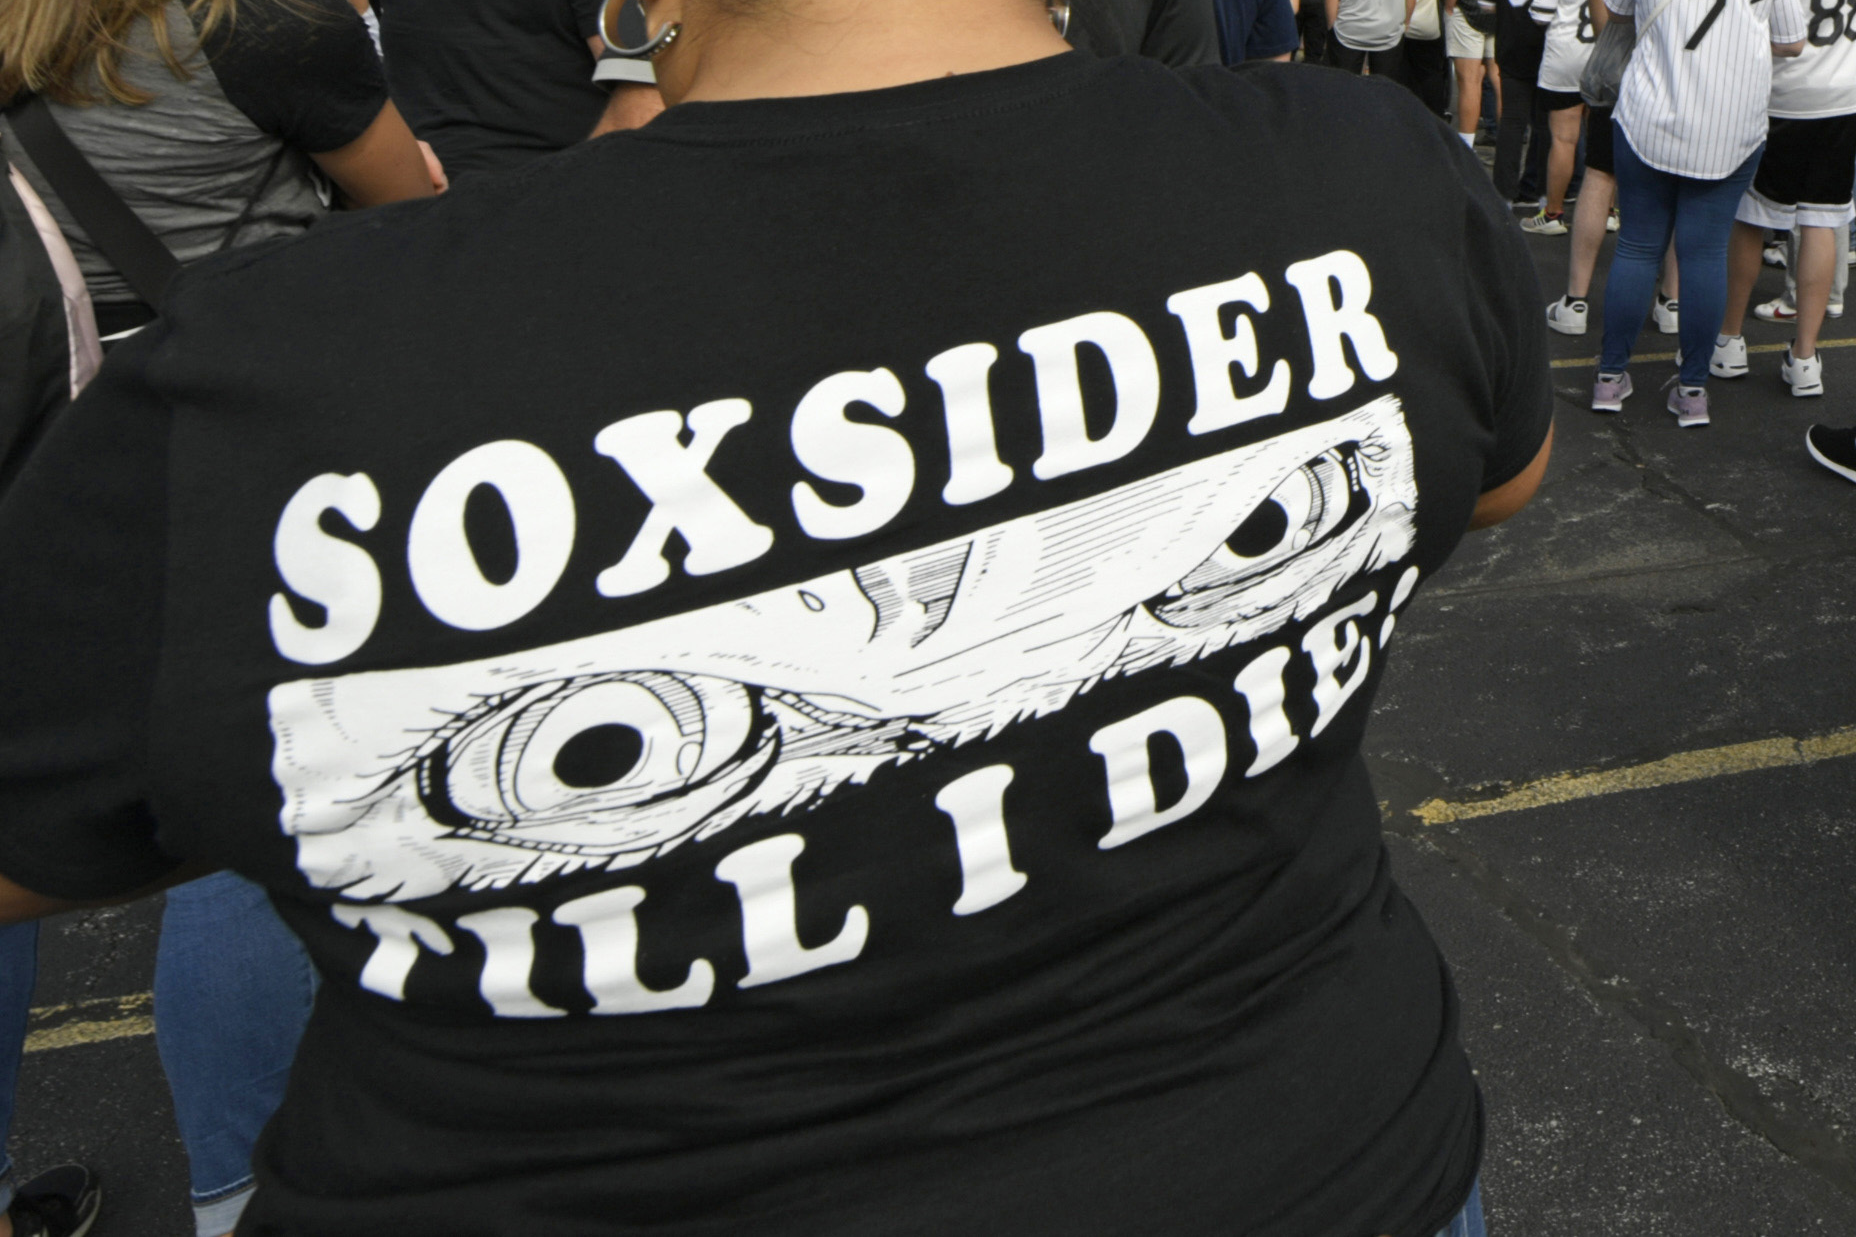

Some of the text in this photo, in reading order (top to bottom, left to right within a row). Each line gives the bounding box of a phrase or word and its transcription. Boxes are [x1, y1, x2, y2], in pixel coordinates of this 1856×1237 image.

[267, 249, 1399, 665] SOXSIDER
[332, 834, 869, 1018] TILL
[935, 764, 1029, 917] I
